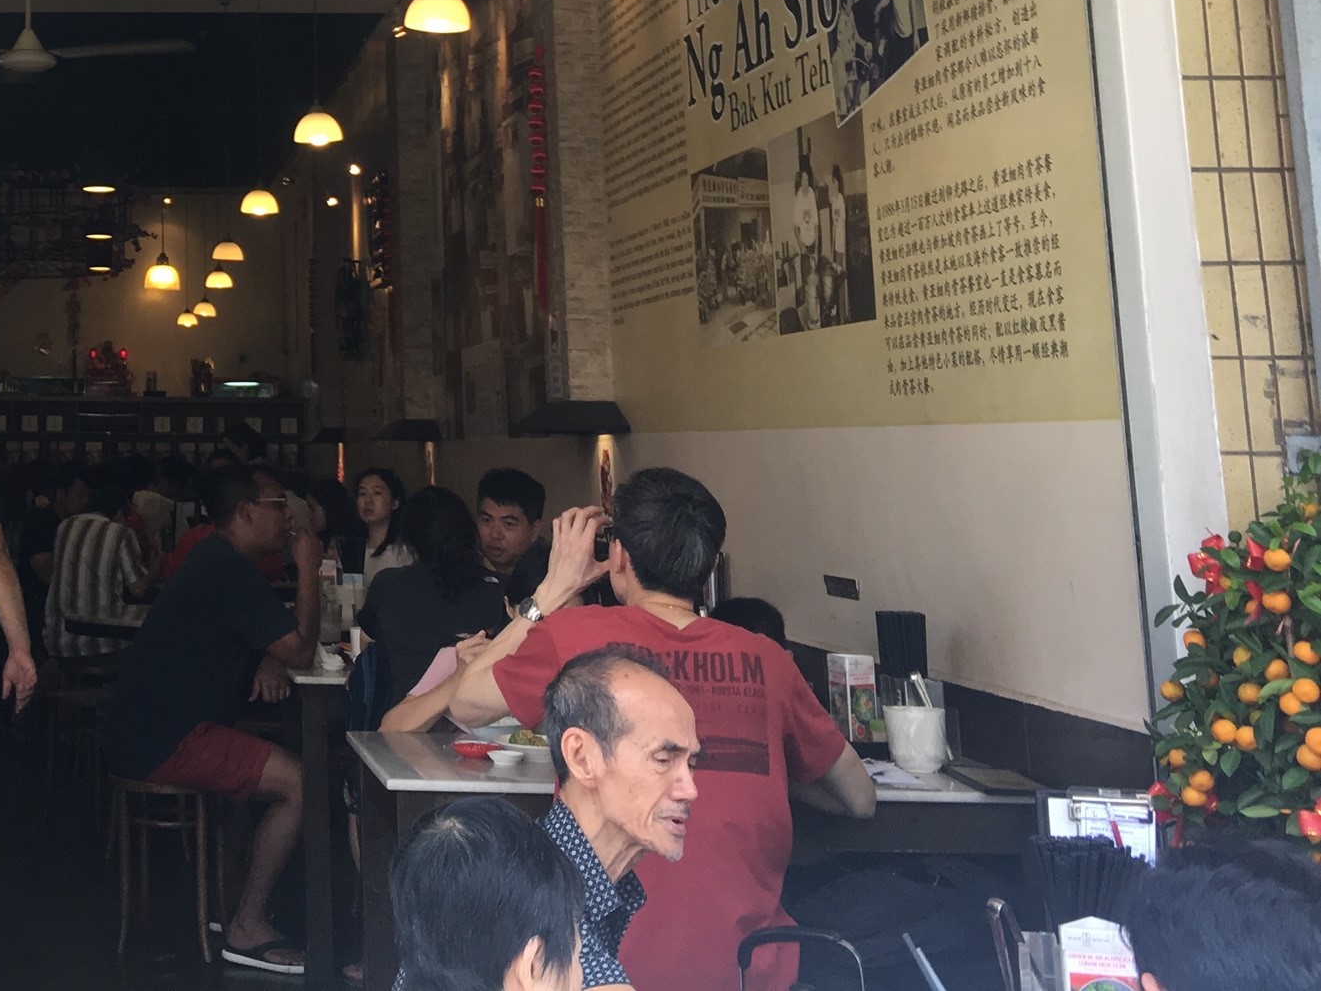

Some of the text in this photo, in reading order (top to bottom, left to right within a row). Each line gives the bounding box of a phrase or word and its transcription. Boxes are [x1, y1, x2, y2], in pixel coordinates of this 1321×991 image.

[684, 24, 726, 121] Ng
[728, 42, 831, 133] Bak Kut Teh
